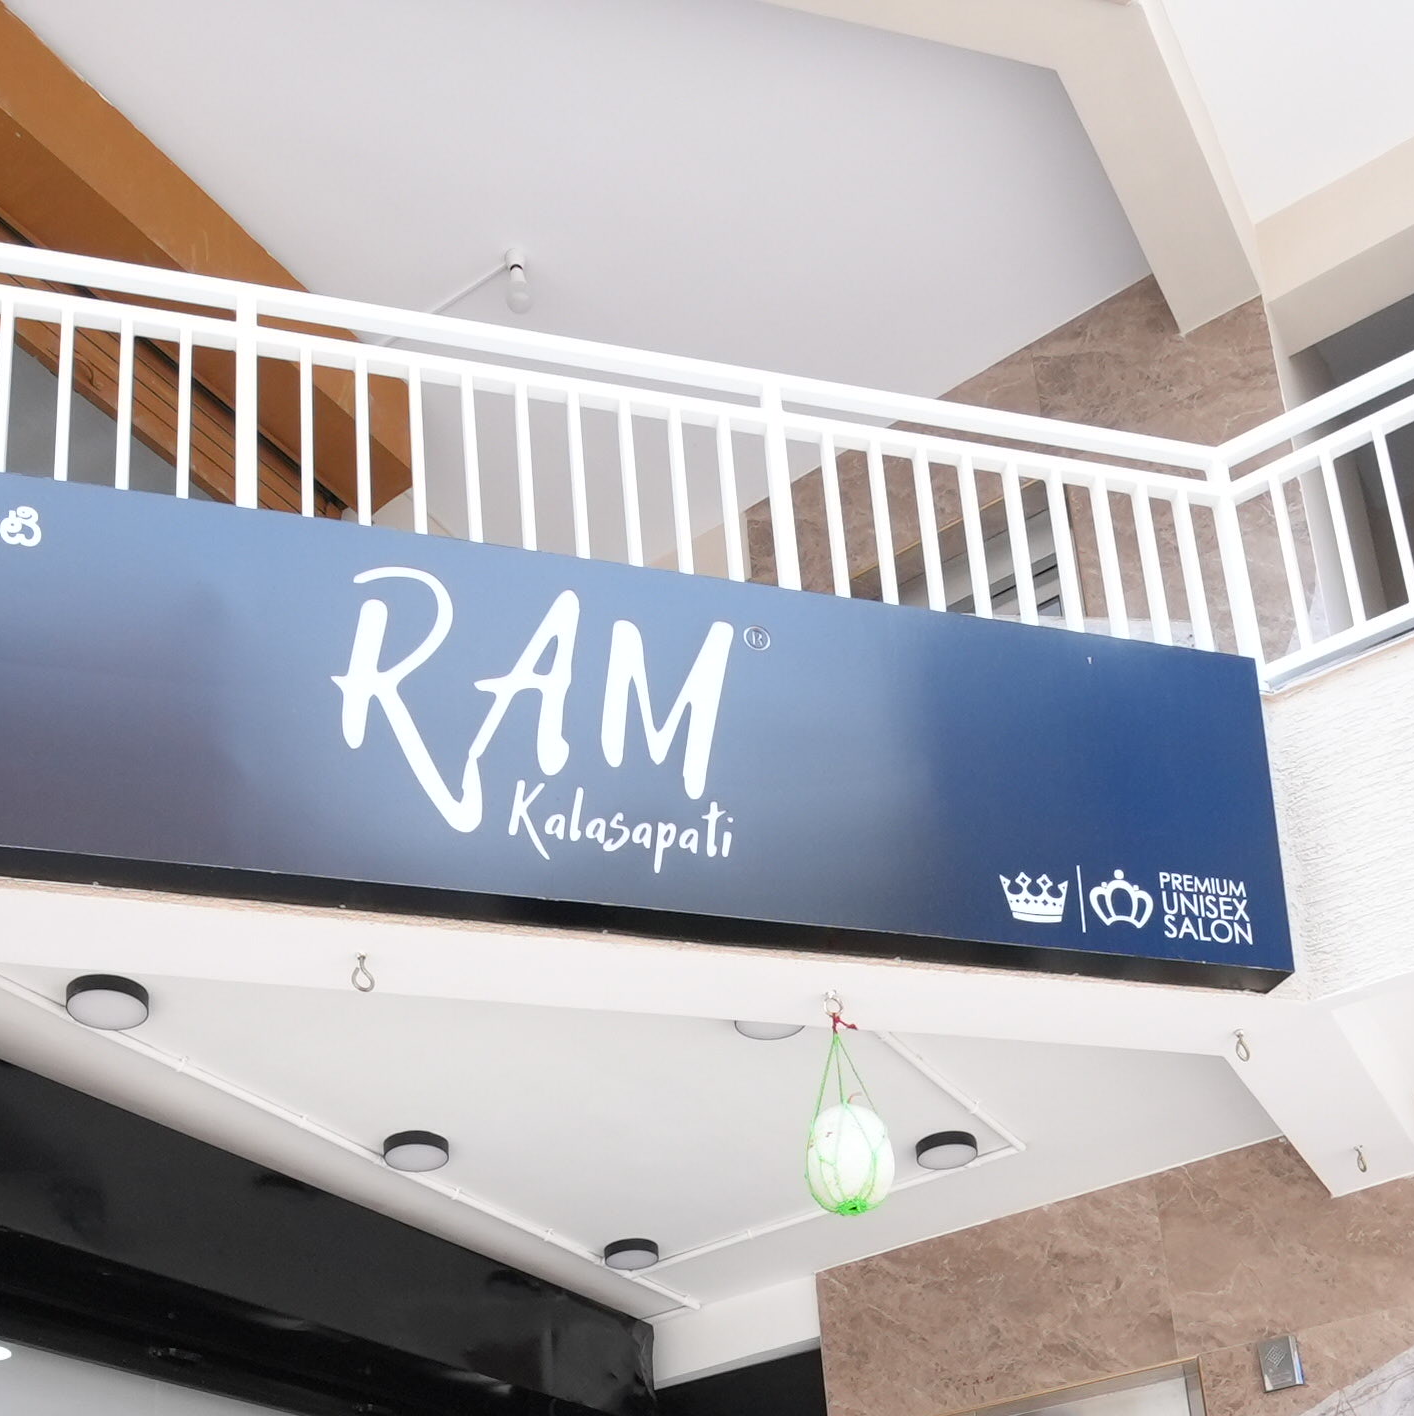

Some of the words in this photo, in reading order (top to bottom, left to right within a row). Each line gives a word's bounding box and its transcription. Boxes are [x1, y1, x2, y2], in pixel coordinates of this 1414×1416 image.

[330, 566, 735, 833] RAM
[508, 779, 734, 874] Kalasapati
[1158, 871, 1247, 898] PREMIUM
[1161, 890, 1250, 922] UNISEX
[1163, 914, 1254, 945] SALON
